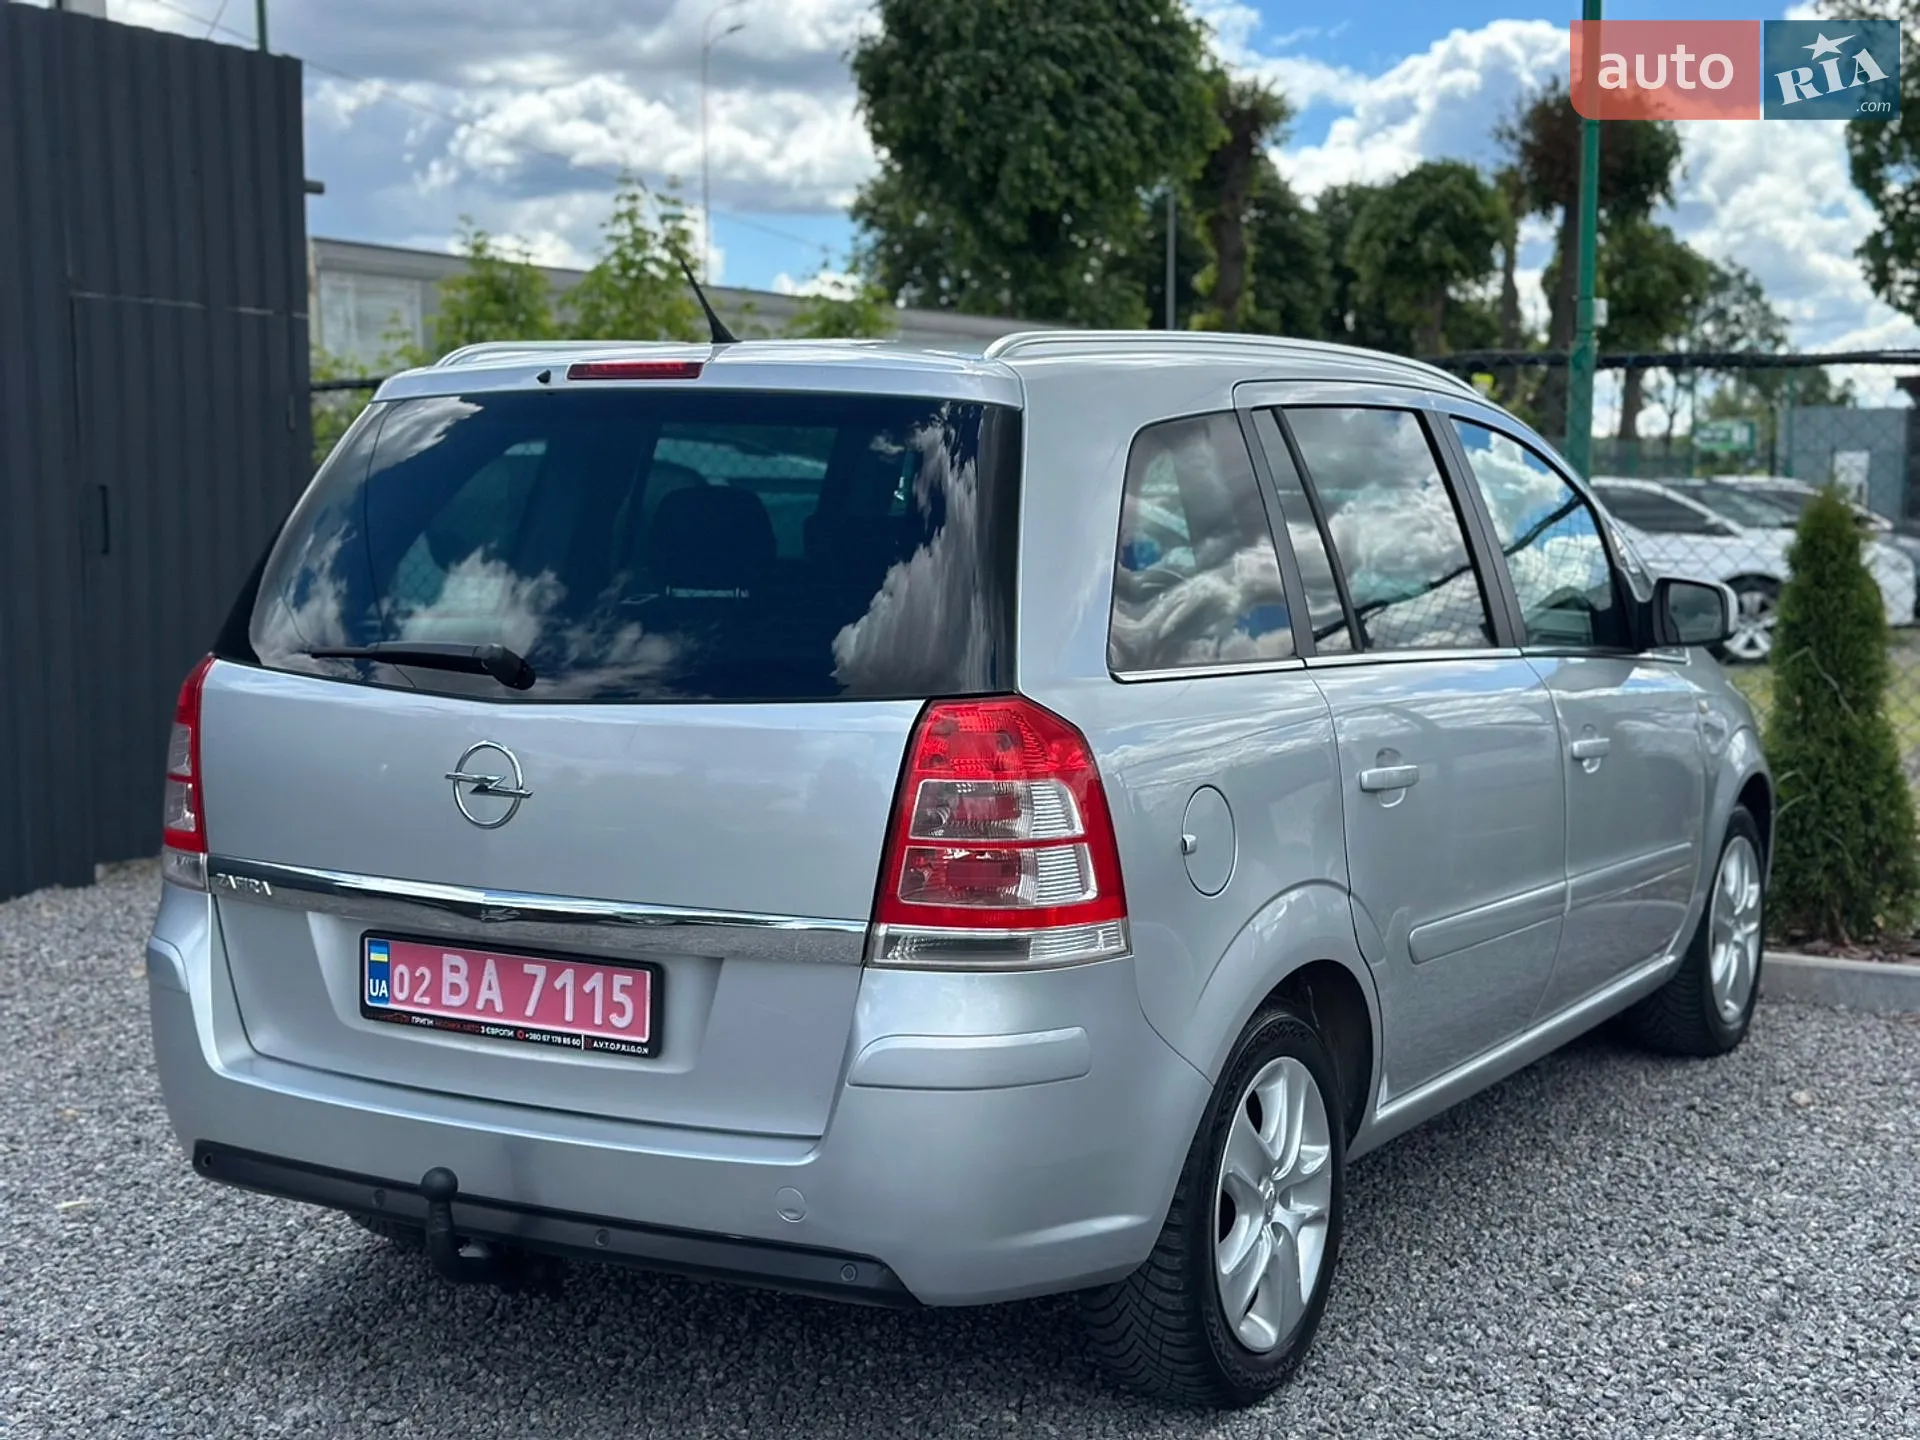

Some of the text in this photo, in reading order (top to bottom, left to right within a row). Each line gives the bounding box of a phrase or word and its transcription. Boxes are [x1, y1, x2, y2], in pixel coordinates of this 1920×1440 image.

[369, 978, 389, 997] UA
[393, 953, 635, 1029] 02 BA 7115
